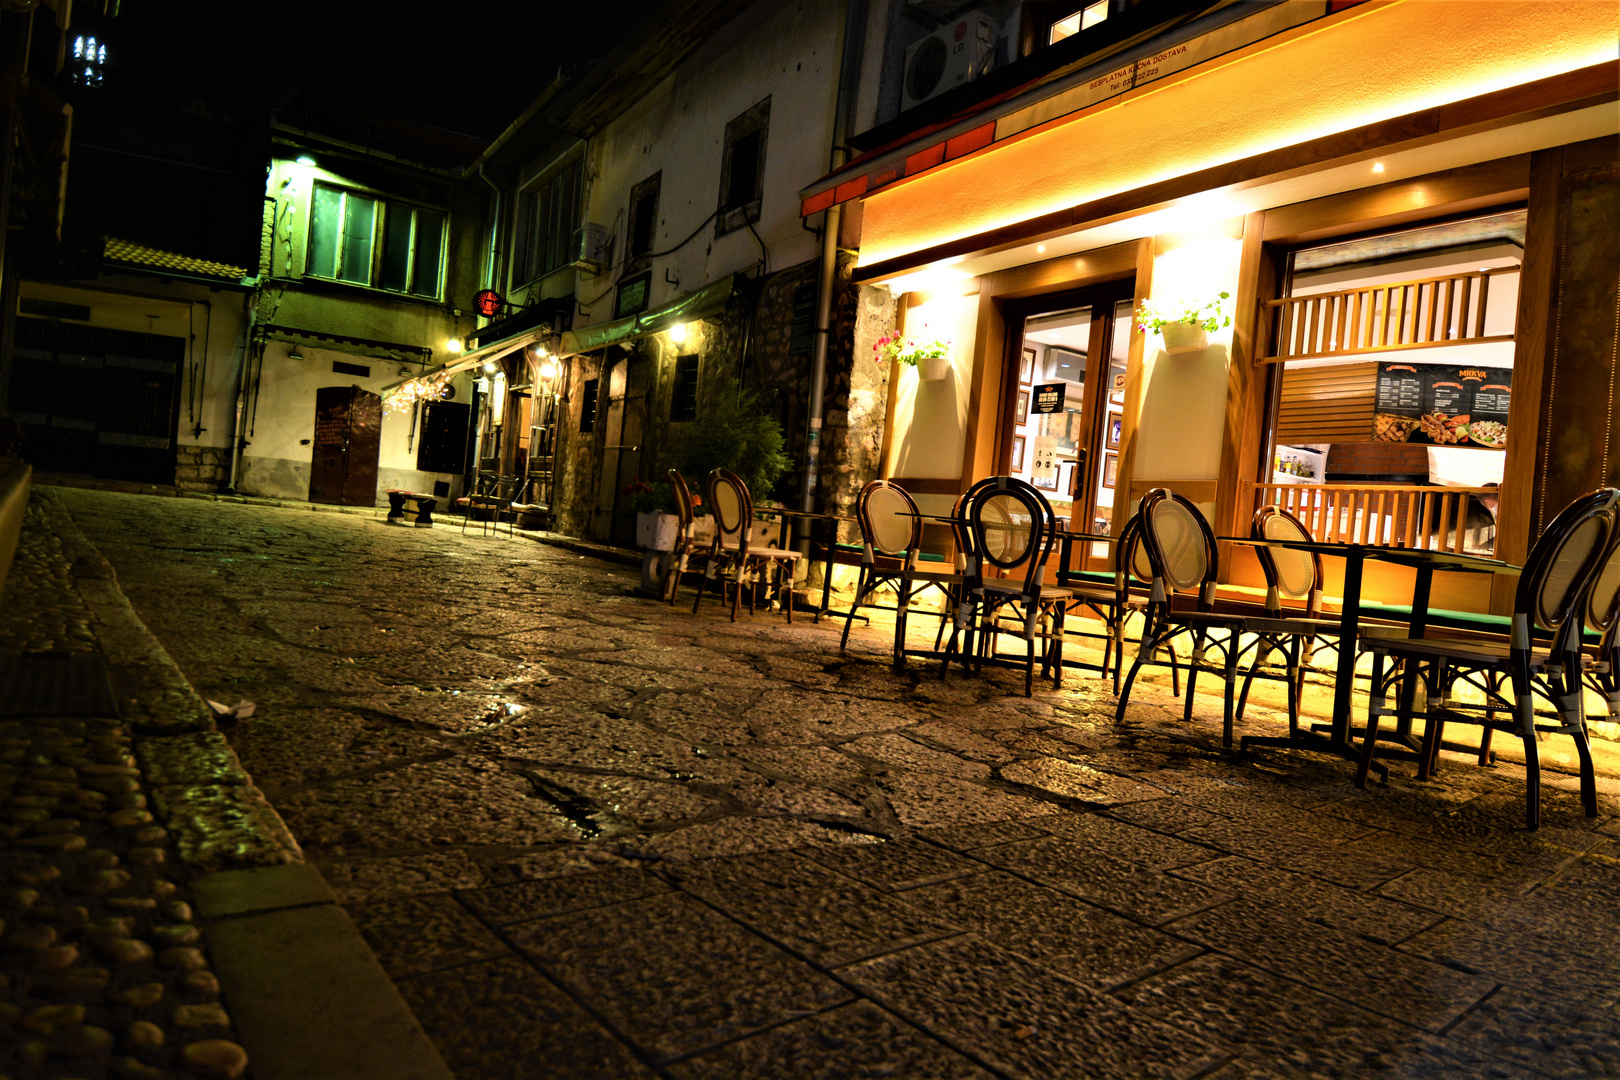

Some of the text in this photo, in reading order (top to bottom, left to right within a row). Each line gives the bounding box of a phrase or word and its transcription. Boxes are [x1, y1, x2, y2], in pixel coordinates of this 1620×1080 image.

[953, 42, 964, 55] LG
[1089, 70, 1127, 90] BESPLATNA
[1152, 46, 1187, 64] DOSTAVA
[1458, 369, 1487, 379] MRKVA
